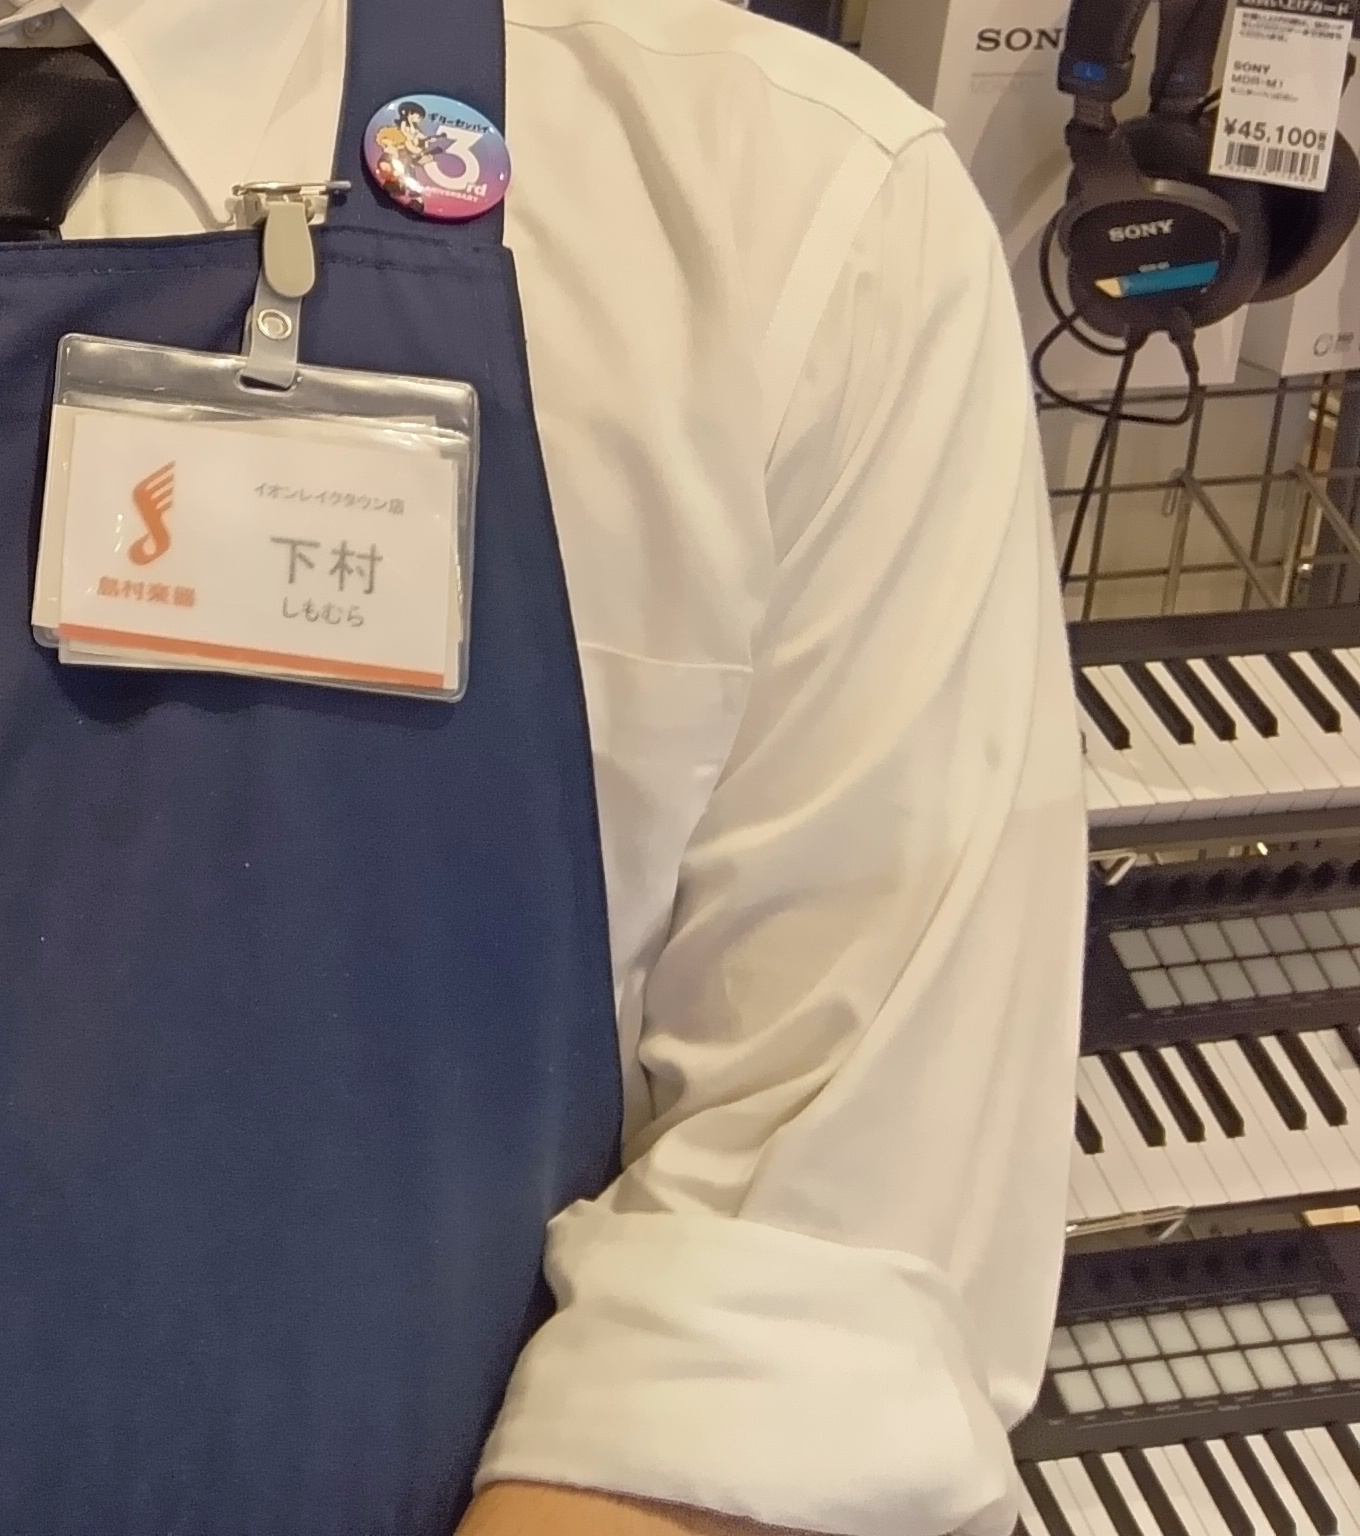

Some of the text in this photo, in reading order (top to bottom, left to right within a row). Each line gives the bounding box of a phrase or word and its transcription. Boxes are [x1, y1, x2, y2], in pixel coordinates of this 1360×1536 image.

[975, 27, 1064, 53] SON
[1233, 60, 1271, 75] SONY
[1224, 116, 1317, 149] ¥45,100
[1108, 219, 1174, 243] SONY
[254, 482, 406, 516] イオンレイクタウン店
[270, 535, 383, 595] 下村
[97, 576, 197, 608] 島村楽器
[281, 597, 366, 628] しもむら
